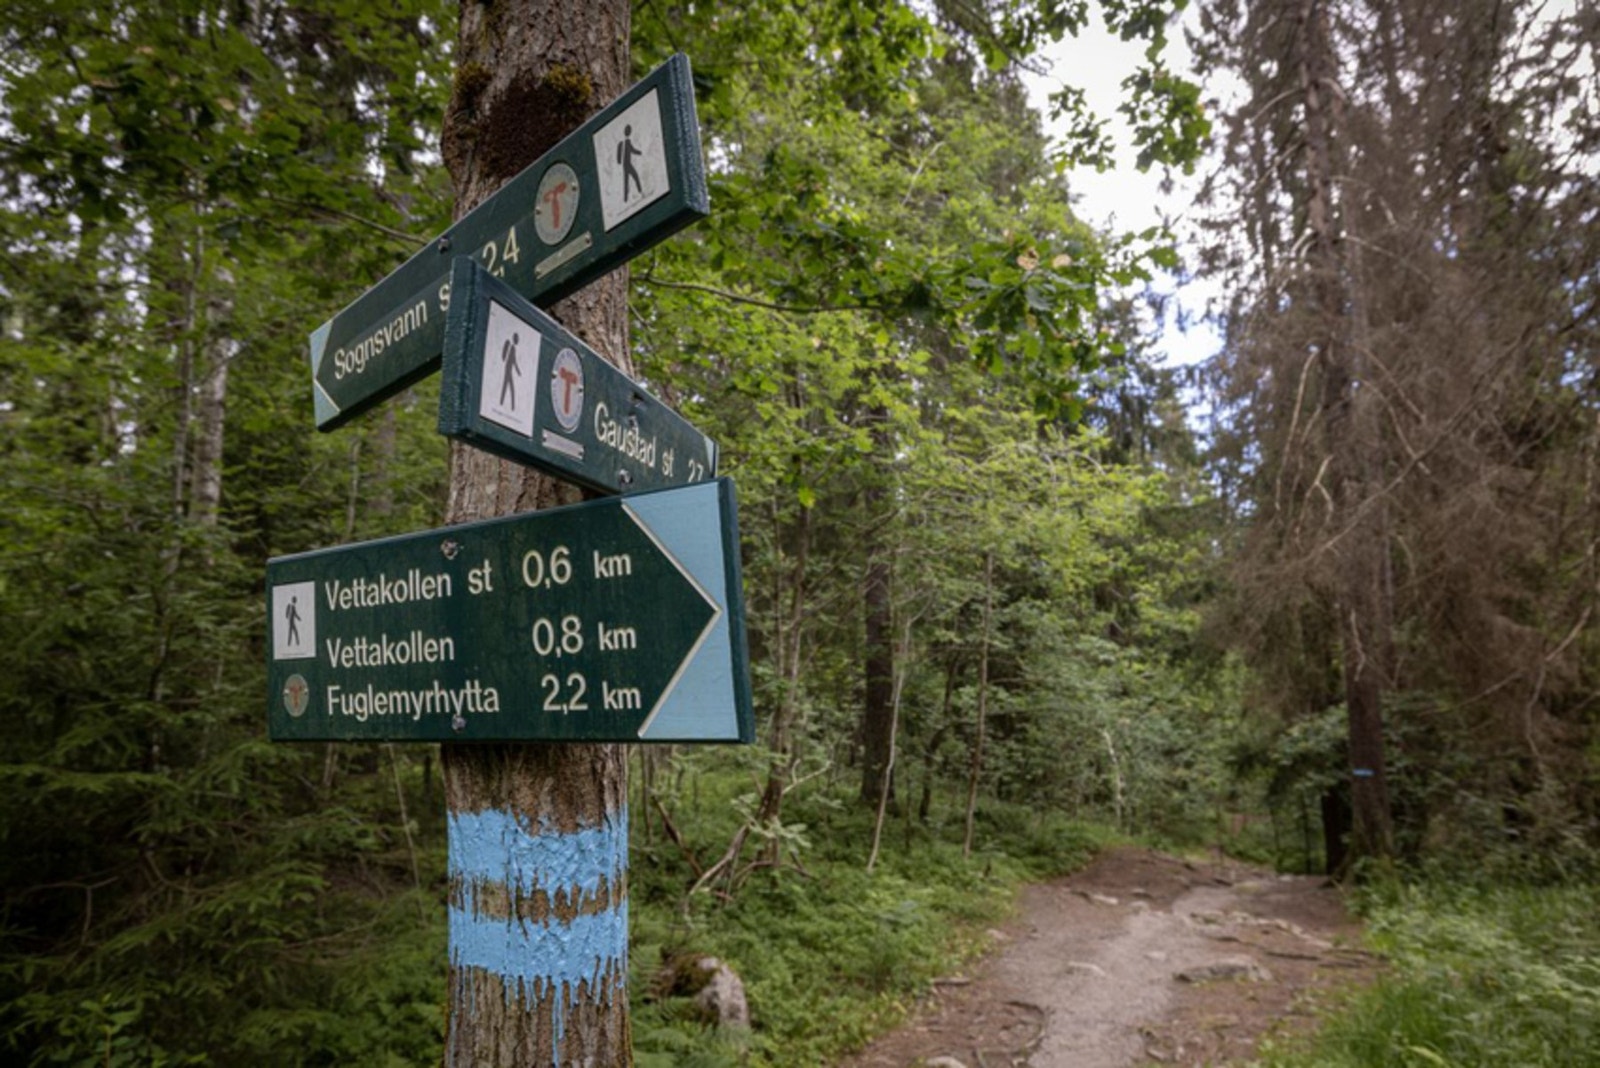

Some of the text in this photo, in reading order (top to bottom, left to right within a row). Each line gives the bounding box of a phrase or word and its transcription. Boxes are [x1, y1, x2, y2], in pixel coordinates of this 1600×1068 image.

[334, 300, 428, 380] Sognsvann
[438, 284, 452, 312] s
[482, 226, 520, 277] 2,4
[594, 401, 656, 469] Gaustad
[662, 448, 674, 478] st
[324, 546, 632, 611] Vettakollen st 0,6 km
[326, 615, 637, 668] Vettakollen 0,8 km
[327, 673, 642, 722] Fuglemyrhytta 2,2 km
